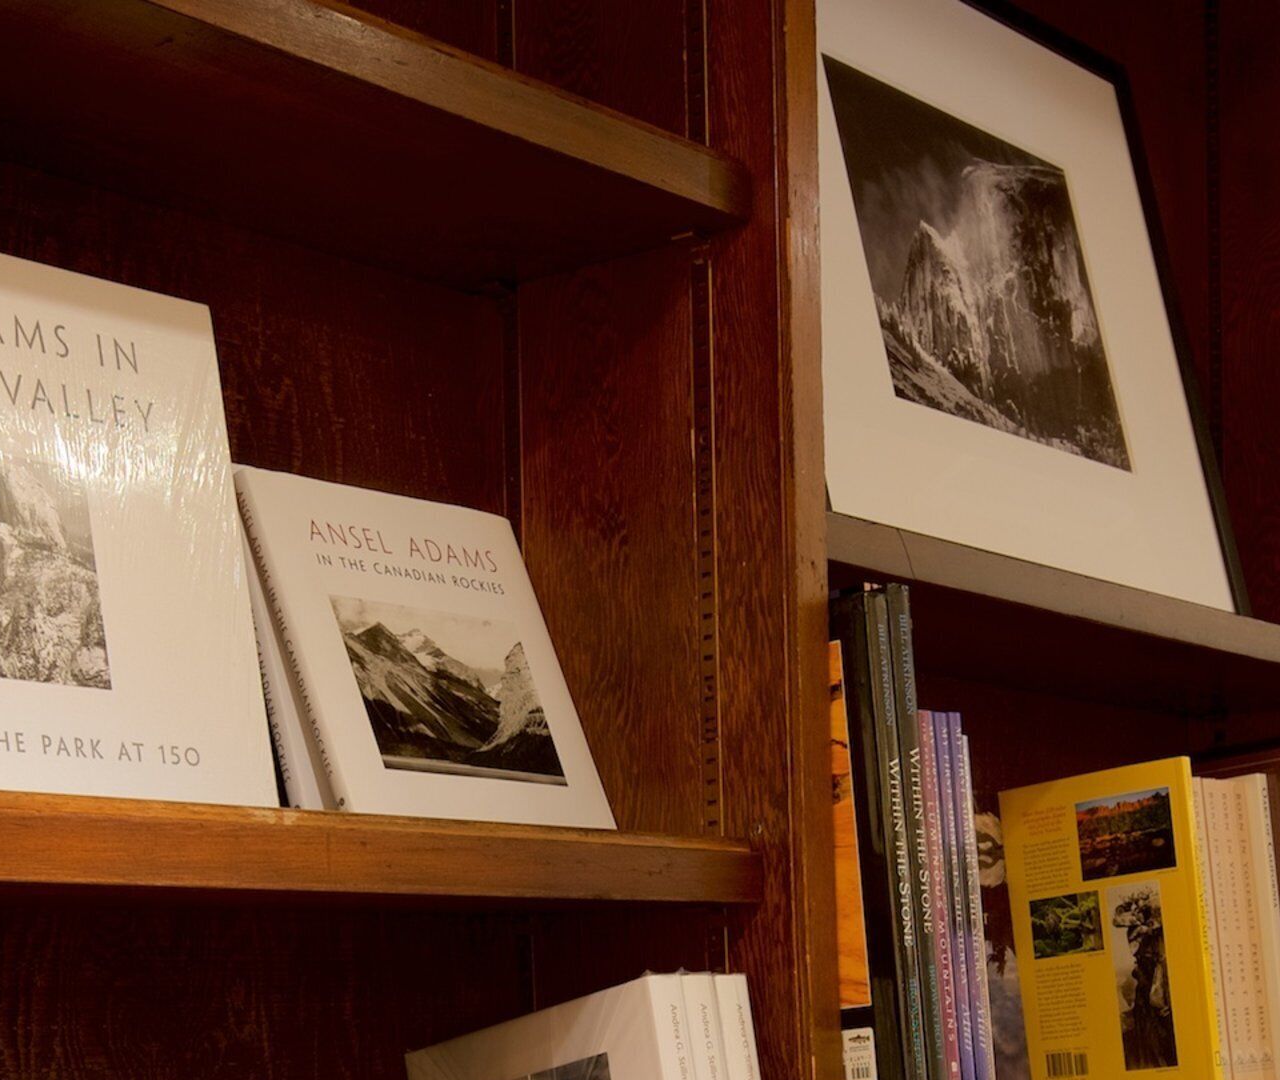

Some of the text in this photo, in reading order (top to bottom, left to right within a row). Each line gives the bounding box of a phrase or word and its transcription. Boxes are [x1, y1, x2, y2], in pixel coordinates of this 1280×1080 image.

[95, 334, 139, 374] IN
[310, 519, 498, 573] ANSEL ADAMS
[316, 553, 505, 595] IN THE CANADIAN ROCKIES
[41, 734, 104, 760] PARK
[118, 743, 144, 762] AT
[158, 745, 200, 767] 150
[889, 758, 913, 947] WITHIN THE STONE
[909, 748, 934, 933] WITHIN THE STONE
[927, 802, 955, 1042] LUMINOUS MOUNTAINS
[671, 1004, 681, 1040] Andrea
[701, 1003, 710, 1039] Andrea
